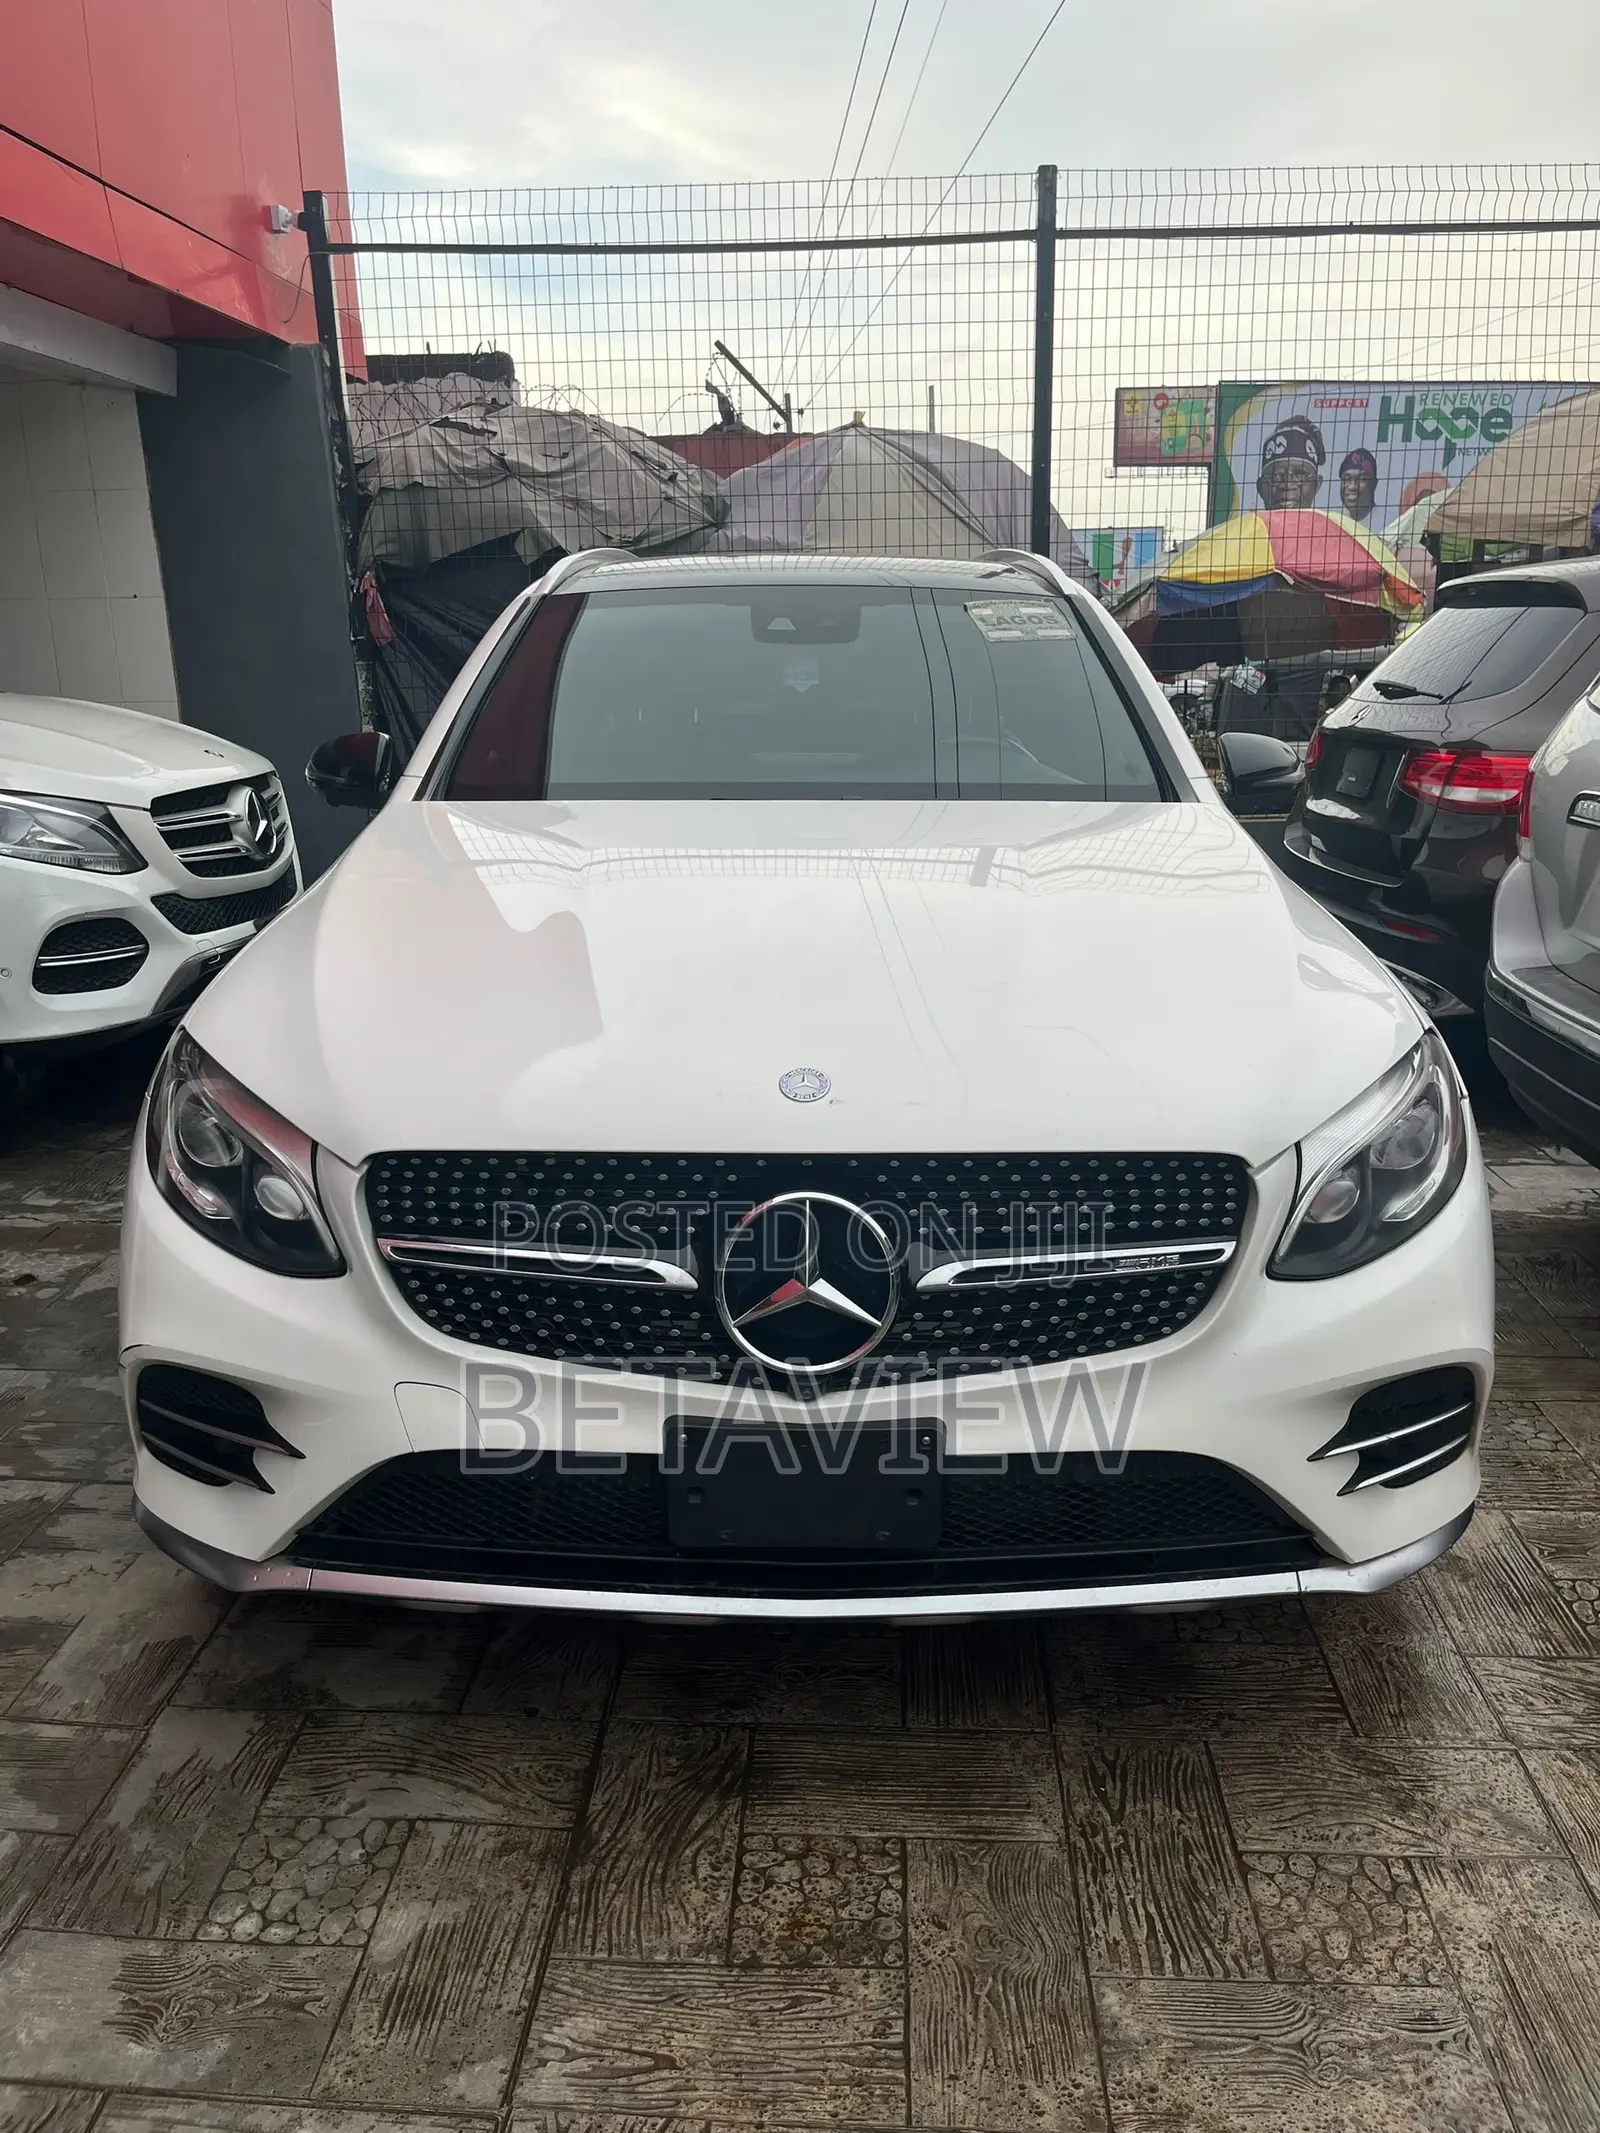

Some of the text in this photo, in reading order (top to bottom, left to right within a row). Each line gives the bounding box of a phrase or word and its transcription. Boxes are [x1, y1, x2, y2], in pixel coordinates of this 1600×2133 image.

[1316, 400, 1368, 408] SUPPORT
[1419, 393, 1513, 406] RENEWED
[1377, 396, 1512, 470] Hope
[1457, 447, 1492, 457] NETW
[978, 615, 1059, 626] LAGOS
